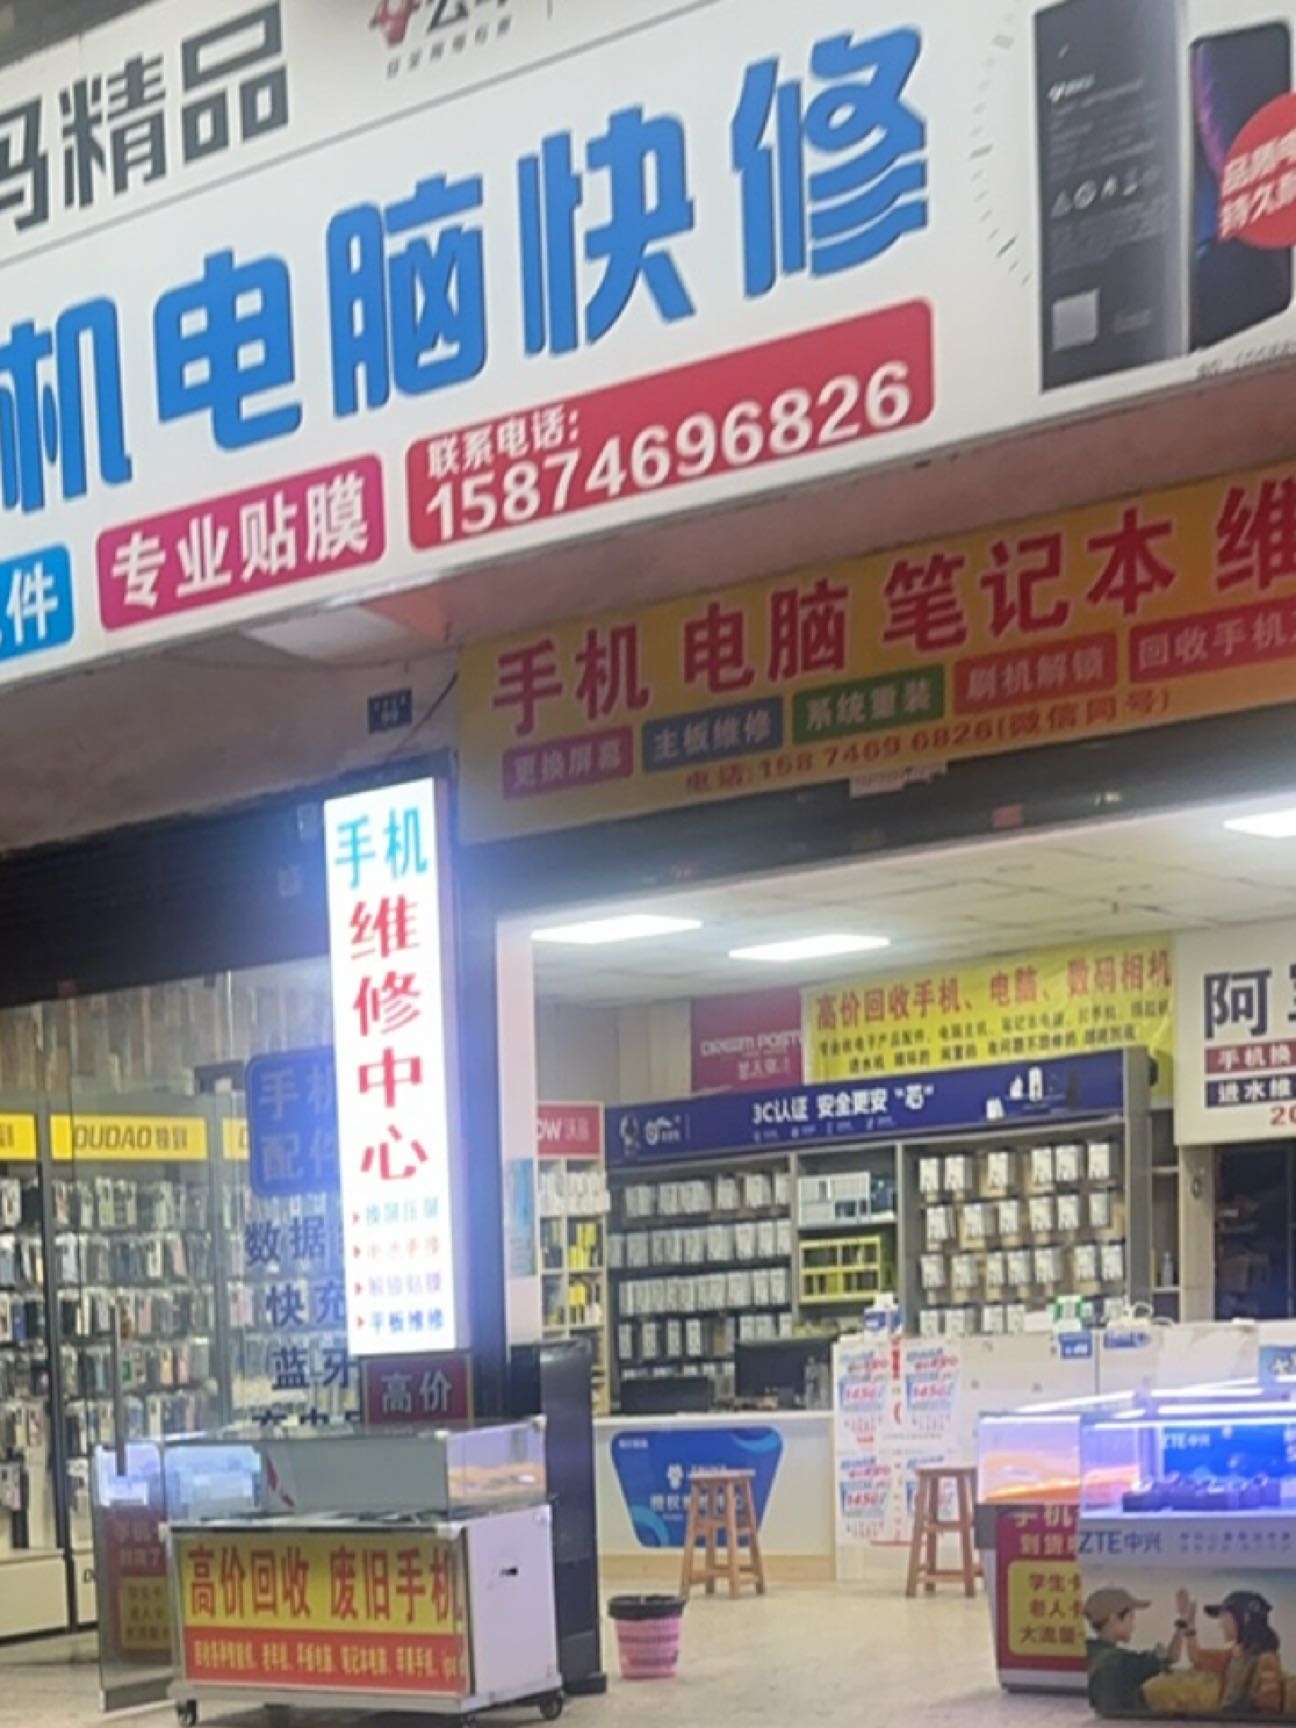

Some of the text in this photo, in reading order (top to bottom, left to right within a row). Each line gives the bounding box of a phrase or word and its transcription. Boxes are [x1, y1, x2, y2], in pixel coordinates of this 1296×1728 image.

[425, 360, 910, 541] 15874696826
[111, 471, 367, 610] 专业贴膜
[492, 622, 650, 736] 手机
[683, 577, 849, 693] 电脑
[882, 507, 1176, 651] 笔记本
[1139, 609, 1296, 671] 回收手机
[653, 709, 771, 761] 主板维修
[335, 807, 428, 888] 手机
[1204, 964, 1296, 1039] 阿
[349, 894, 428, 1180] 维修中心
[245, 1216, 344, 1267] 数据
[266, 1280, 345, 1328] 快充
[271, 1346, 357, 1390] 蓝牙
[380, 1370, 453, 1413] 高价
[1079, 1531, 1161, 1553] ZTE中兴
[188, 1546, 310, 1619] 高价回收
[330, 1545, 463, 1624] 废旧手机
